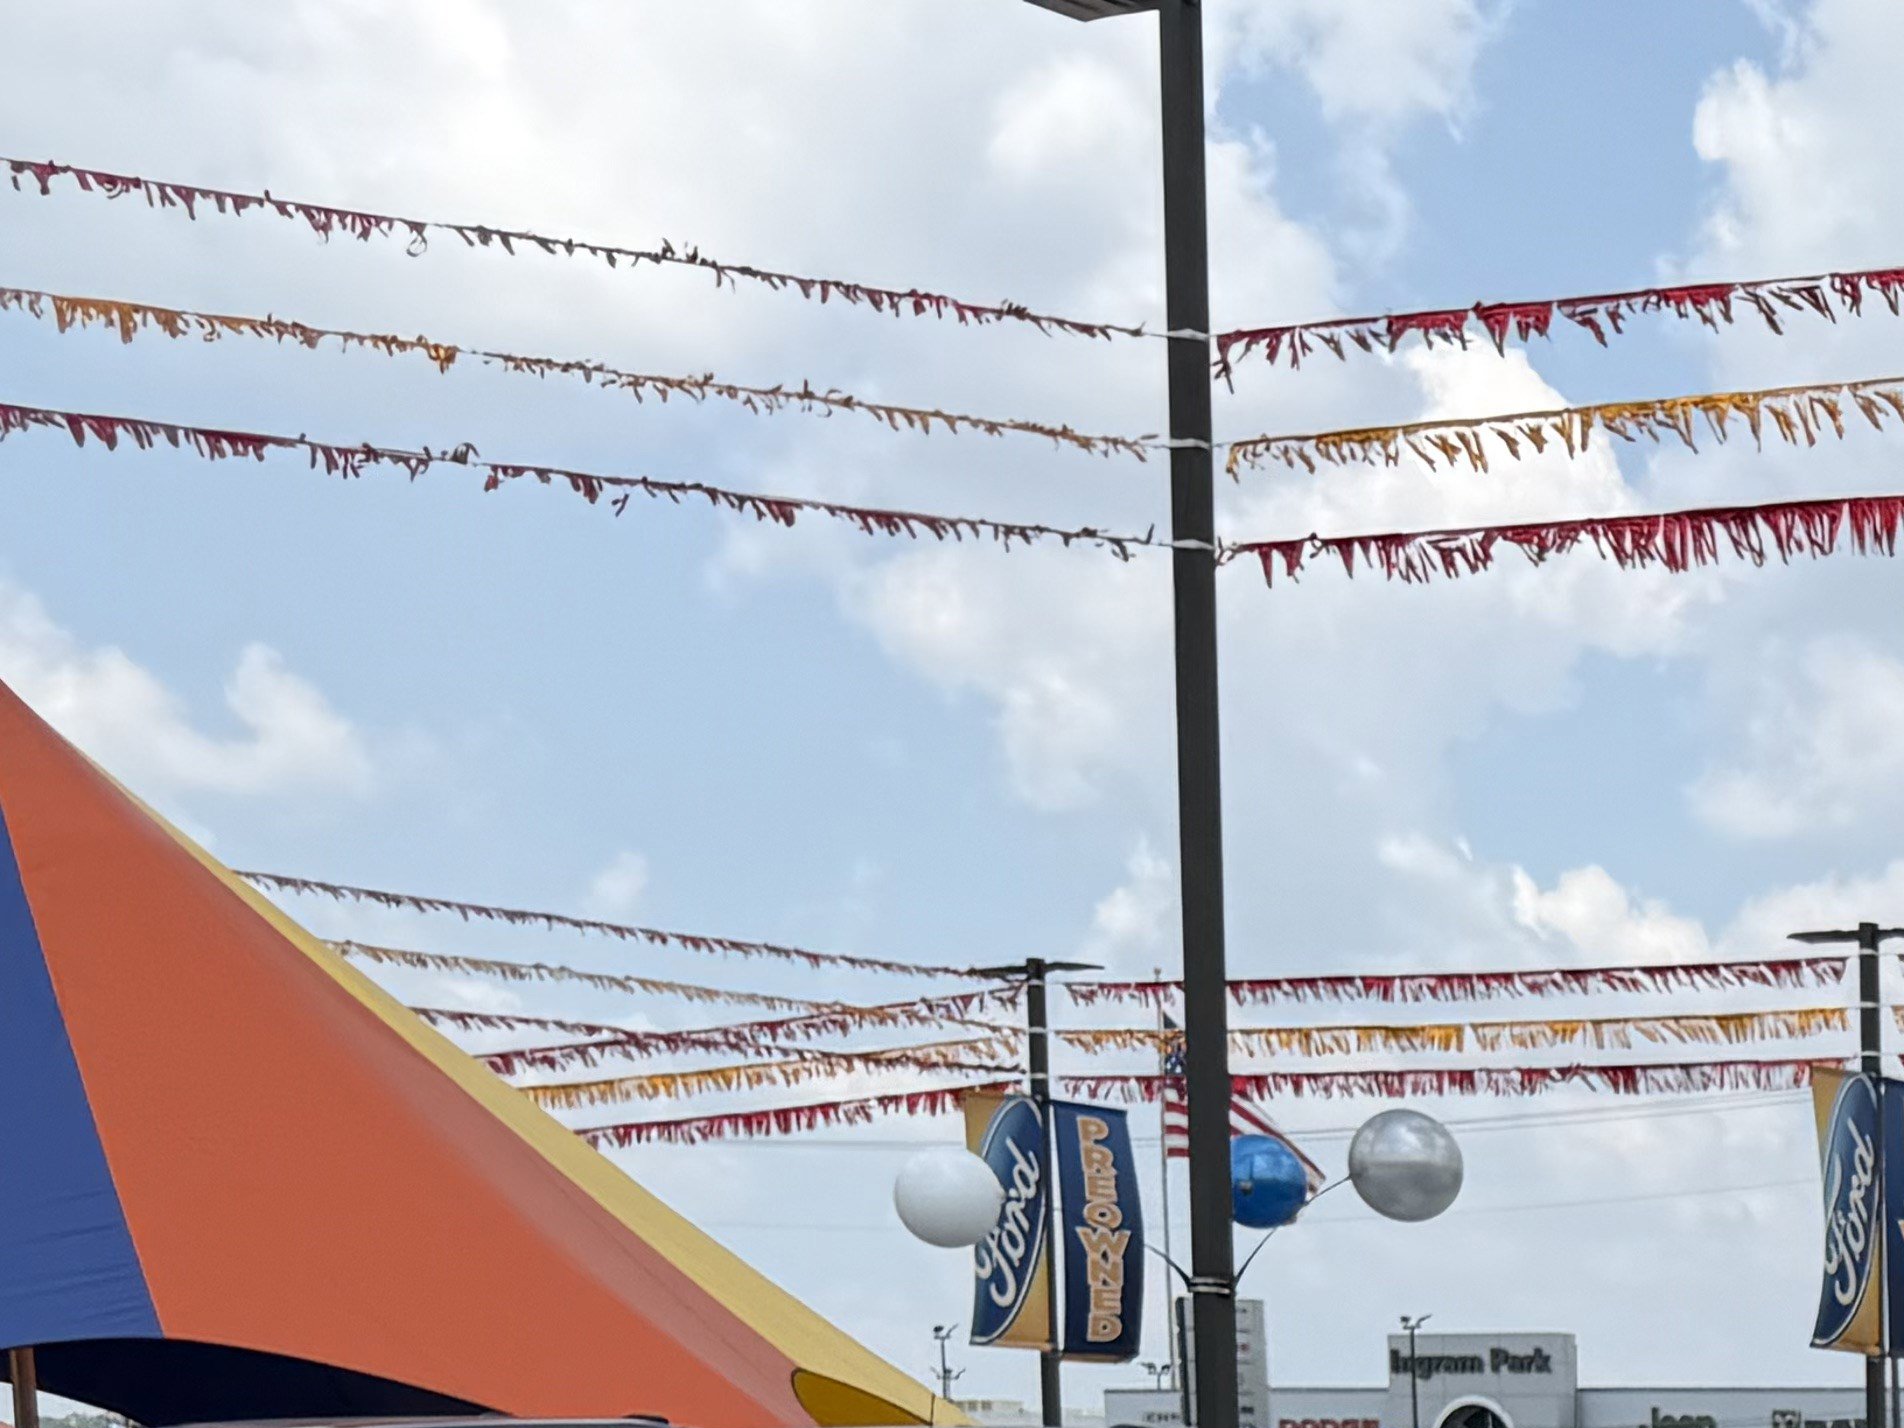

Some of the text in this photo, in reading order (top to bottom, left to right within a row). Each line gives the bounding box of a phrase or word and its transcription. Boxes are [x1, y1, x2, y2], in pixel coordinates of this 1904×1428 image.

[974, 1136, 1041, 1308] Ford
[1075, 1114, 1132, 1343] PREOWNED
[1824, 1116, 1875, 1306] Ford
[1389, 1346, 1552, 1380] Ingram Park
